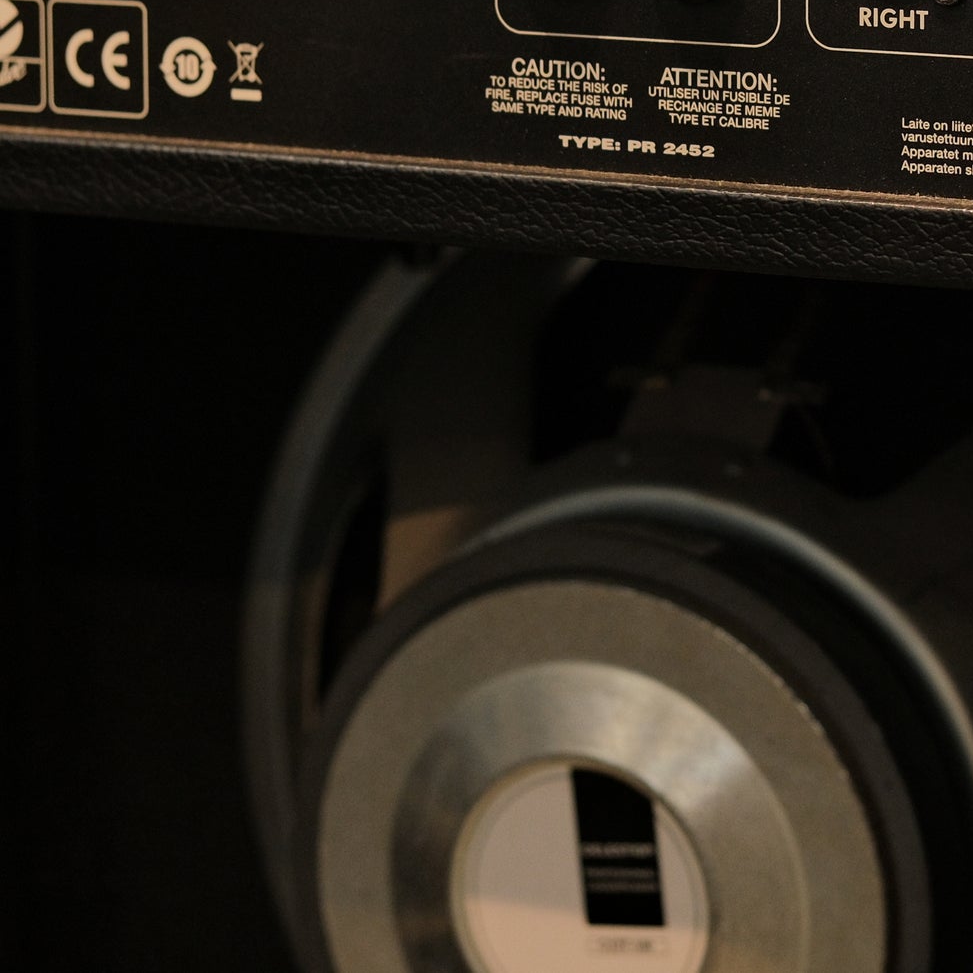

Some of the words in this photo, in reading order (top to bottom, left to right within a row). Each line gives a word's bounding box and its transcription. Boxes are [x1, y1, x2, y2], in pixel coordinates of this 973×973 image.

[858, 7, 929, 31] RIGHT
[65, 28, 131, 90] CE
[511, 56, 606, 82] CAUTION:
[490, 75, 506, 88] TO
[508, 77, 555, 91] REDUCE
[557, 80, 580, 93] THE
[583, 82, 610, 95] RISK
[611, 84, 629, 96] OF
[660, 67, 778, 92] ATTENTION:
[485, 88, 514, 102] FIRE,
[516, 90, 569, 105] REPLACE
[570, 93, 601, 107] FUSE
[603, 96, 633, 109] WITH
[648, 86, 700, 100] UTILISER
[702, 89, 720, 101] UN
[722, 91, 772, 105] FUSIBLE
[774, 94, 791, 106] DE
[491, 100, 524, 114] SAME
[526, 103, 556, 116] TYPE
[557, 105, 583, 118] AND
[585, 108, 627, 122] RATING
[658, 99, 723, 115] RECHANGE
[725, 103, 742, 116] DE
[744, 105, 781, 118] MEME
[668, 113, 699, 125] TYPE
[701, 115, 717, 127] ET
[718, 116, 770, 130] CALIBRE
[901, 117, 930, 130] Laite
[933, 121, 948, 132] on
[558, 134, 621, 151] TYPE:
[627, 139, 657, 154] PR
[663, 142, 716, 158] 2452
[901, 145, 960, 161] Apparatet
[901, 159, 962, 175] Apparaten
